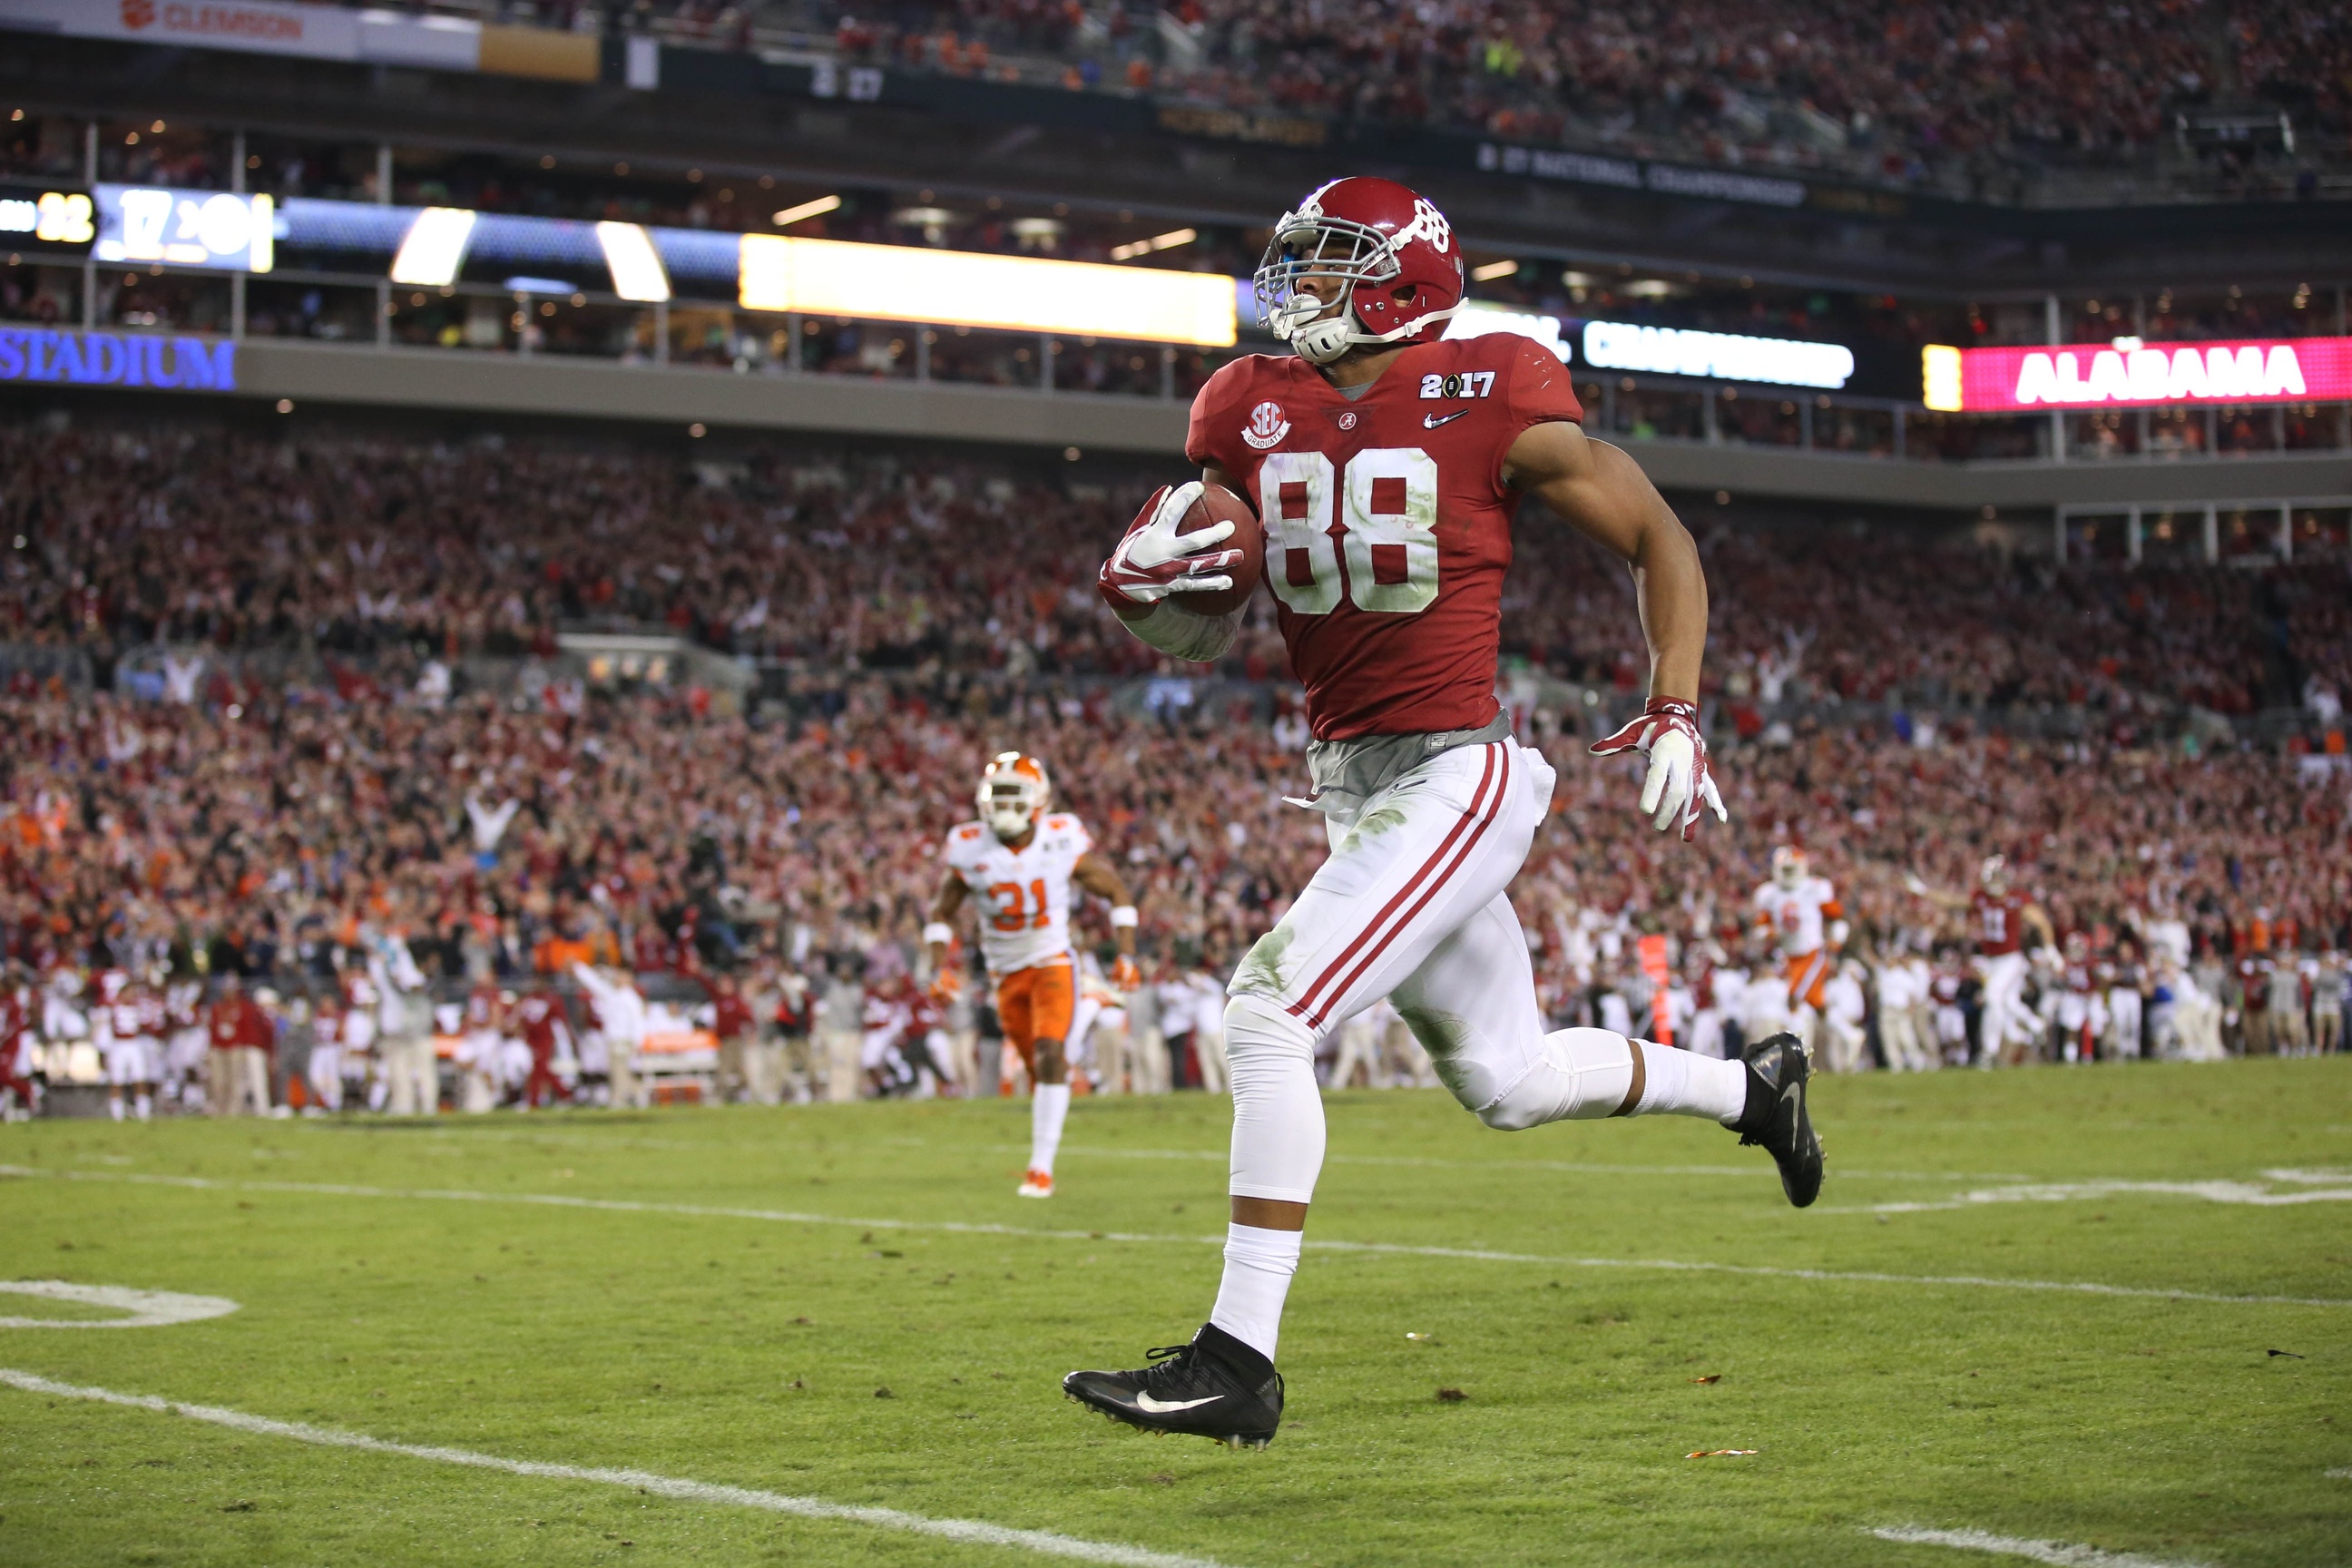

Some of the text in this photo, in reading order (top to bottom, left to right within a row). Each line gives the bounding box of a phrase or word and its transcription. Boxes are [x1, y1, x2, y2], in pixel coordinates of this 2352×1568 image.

[162, 5, 304, 41] CLEMSON
[1413, 198, 1451, 254] 88
[0, 327, 238, 391] STADIUM
[2015, 345, 2307, 404] ALABAMA
[1247, 430, 1284, 448] GRADUATE
[1251, 401, 1281, 436] SEC
[1259, 447, 1439, 615] 88
[988, 878, 1051, 932] 31
